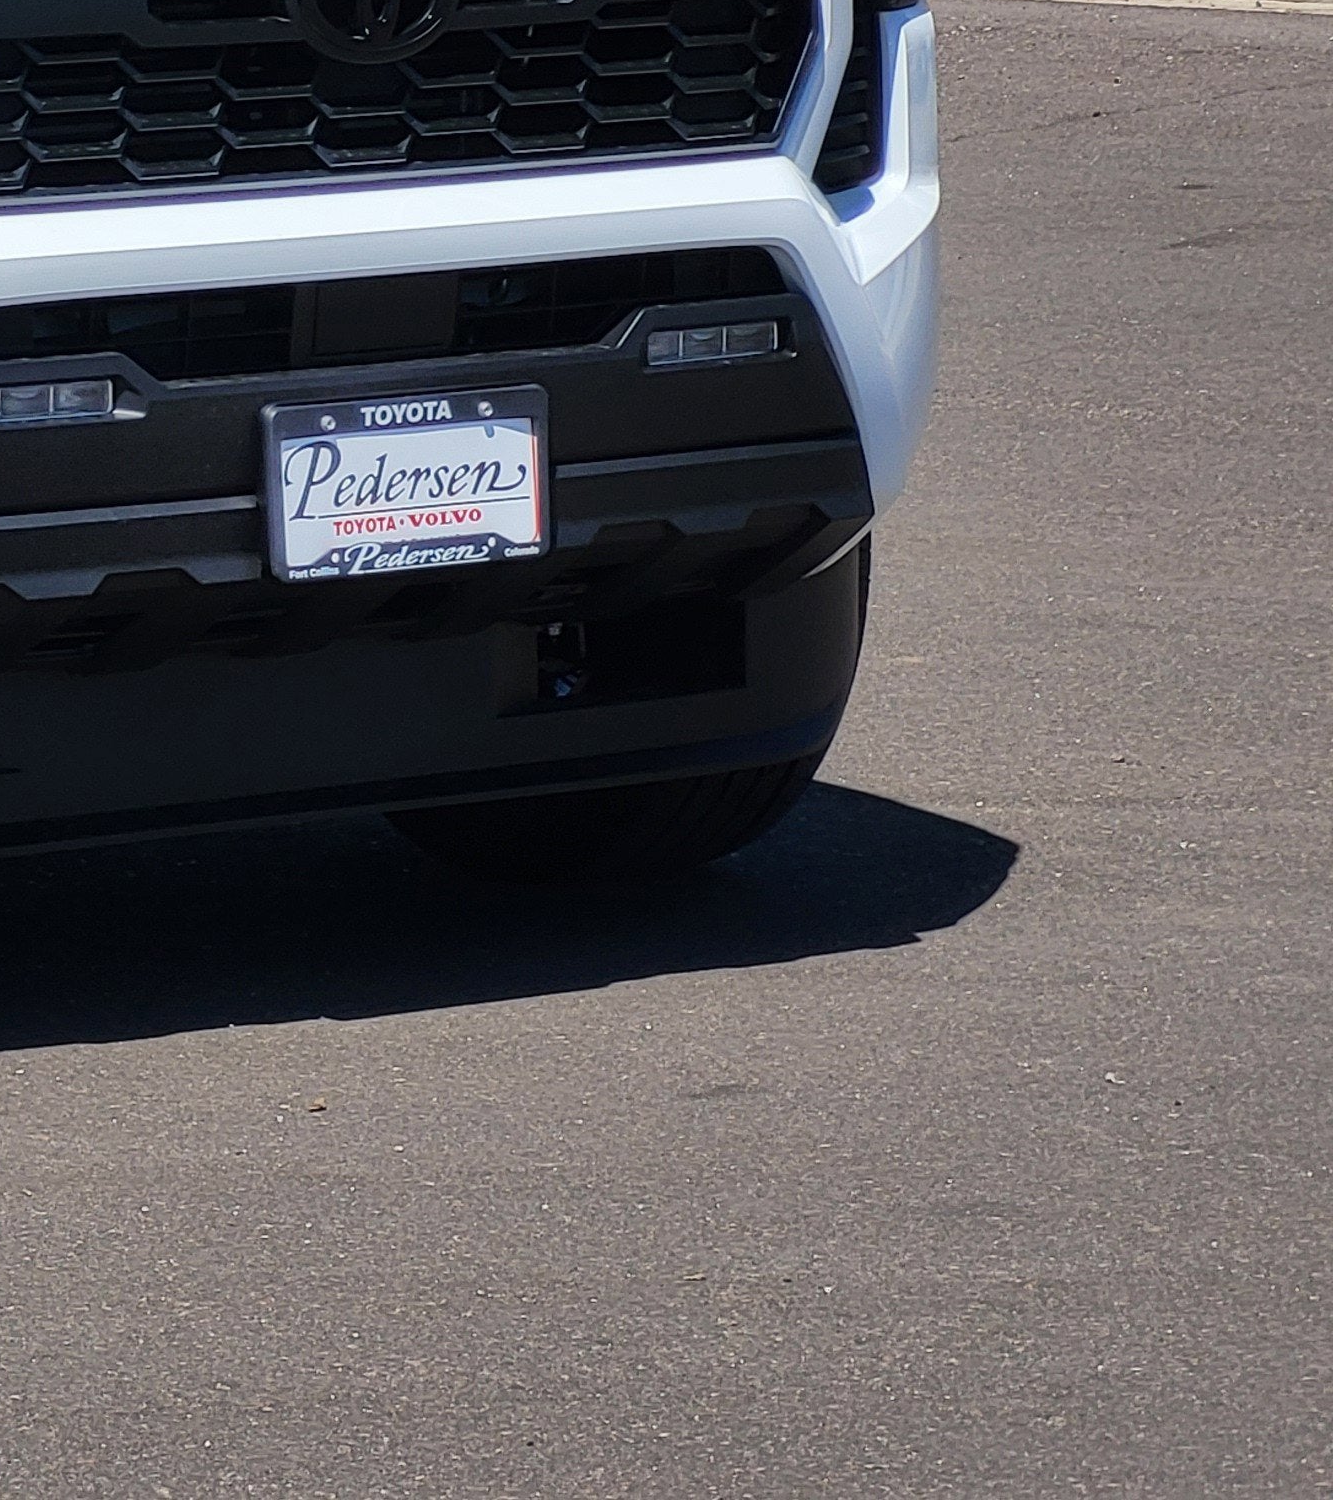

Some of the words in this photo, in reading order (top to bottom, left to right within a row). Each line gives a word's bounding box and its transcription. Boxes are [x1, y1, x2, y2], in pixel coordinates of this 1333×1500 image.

[360, 401, 453, 427] TOYOTA
[284, 441, 527, 521] Pedersen
[333, 516, 396, 536] TOYOTA
[407, 508, 482, 528] VOLVO
[344, 542, 490, 574] Pedersen
